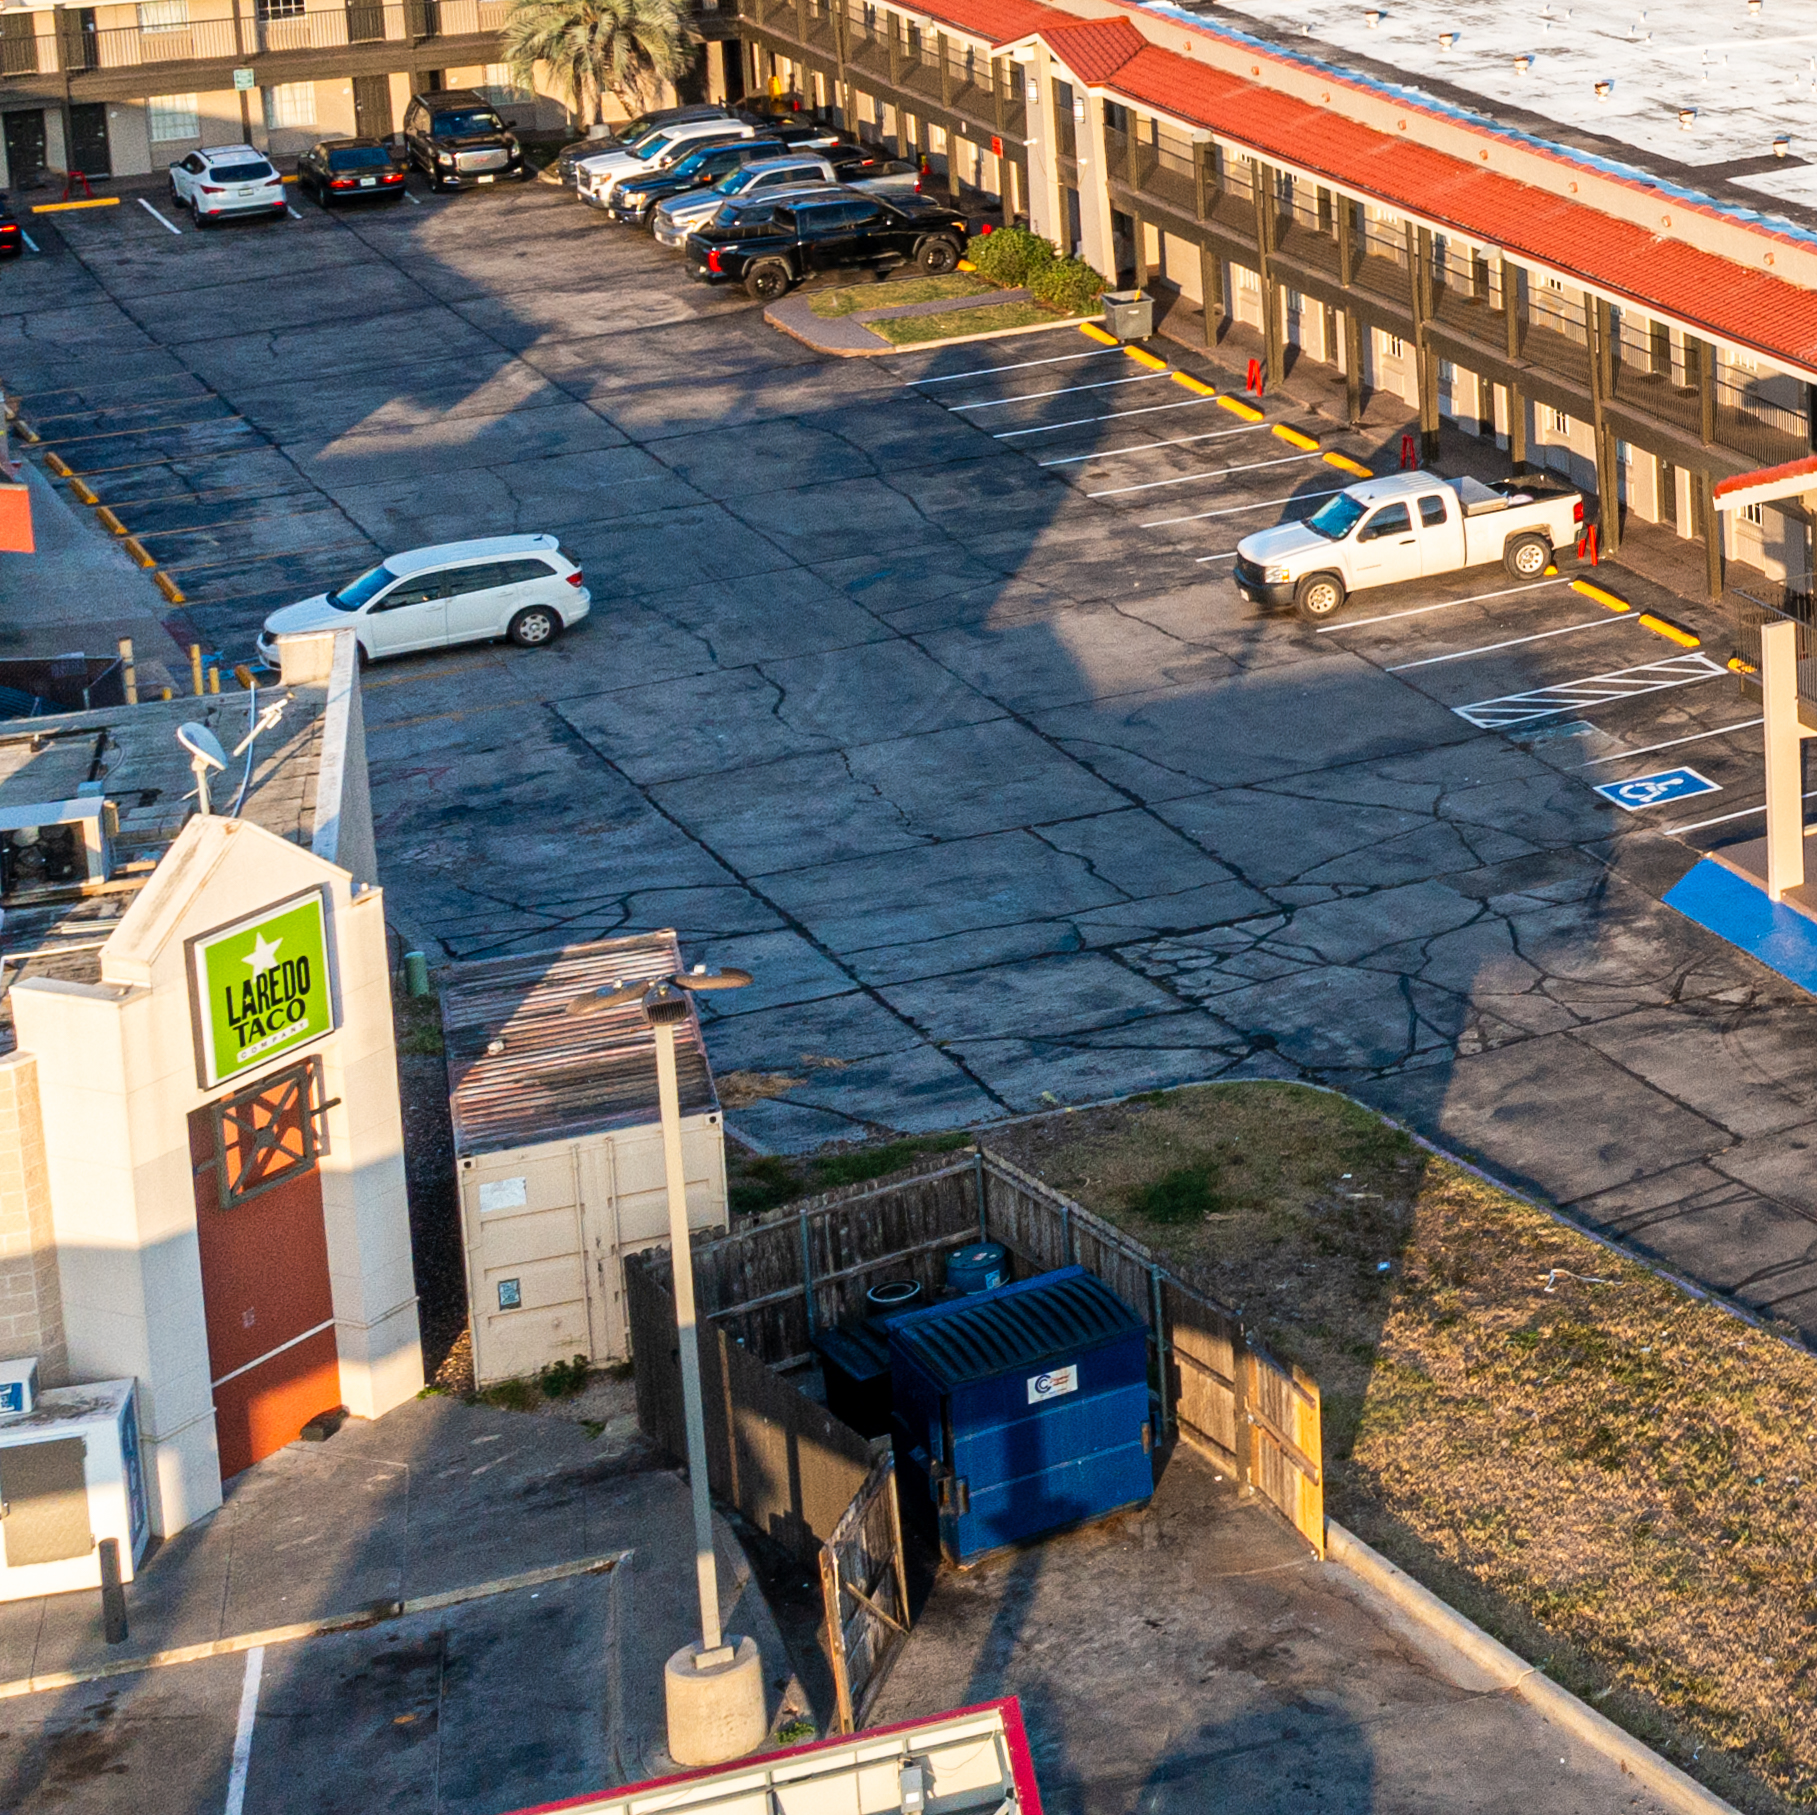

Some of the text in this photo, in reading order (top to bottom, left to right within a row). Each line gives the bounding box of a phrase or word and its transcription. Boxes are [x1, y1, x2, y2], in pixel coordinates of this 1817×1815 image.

[225, 955, 311, 1027] LAREDO
[232, 998, 306, 1048] TACO
[240, 1022, 305, 1059] COMPANY
